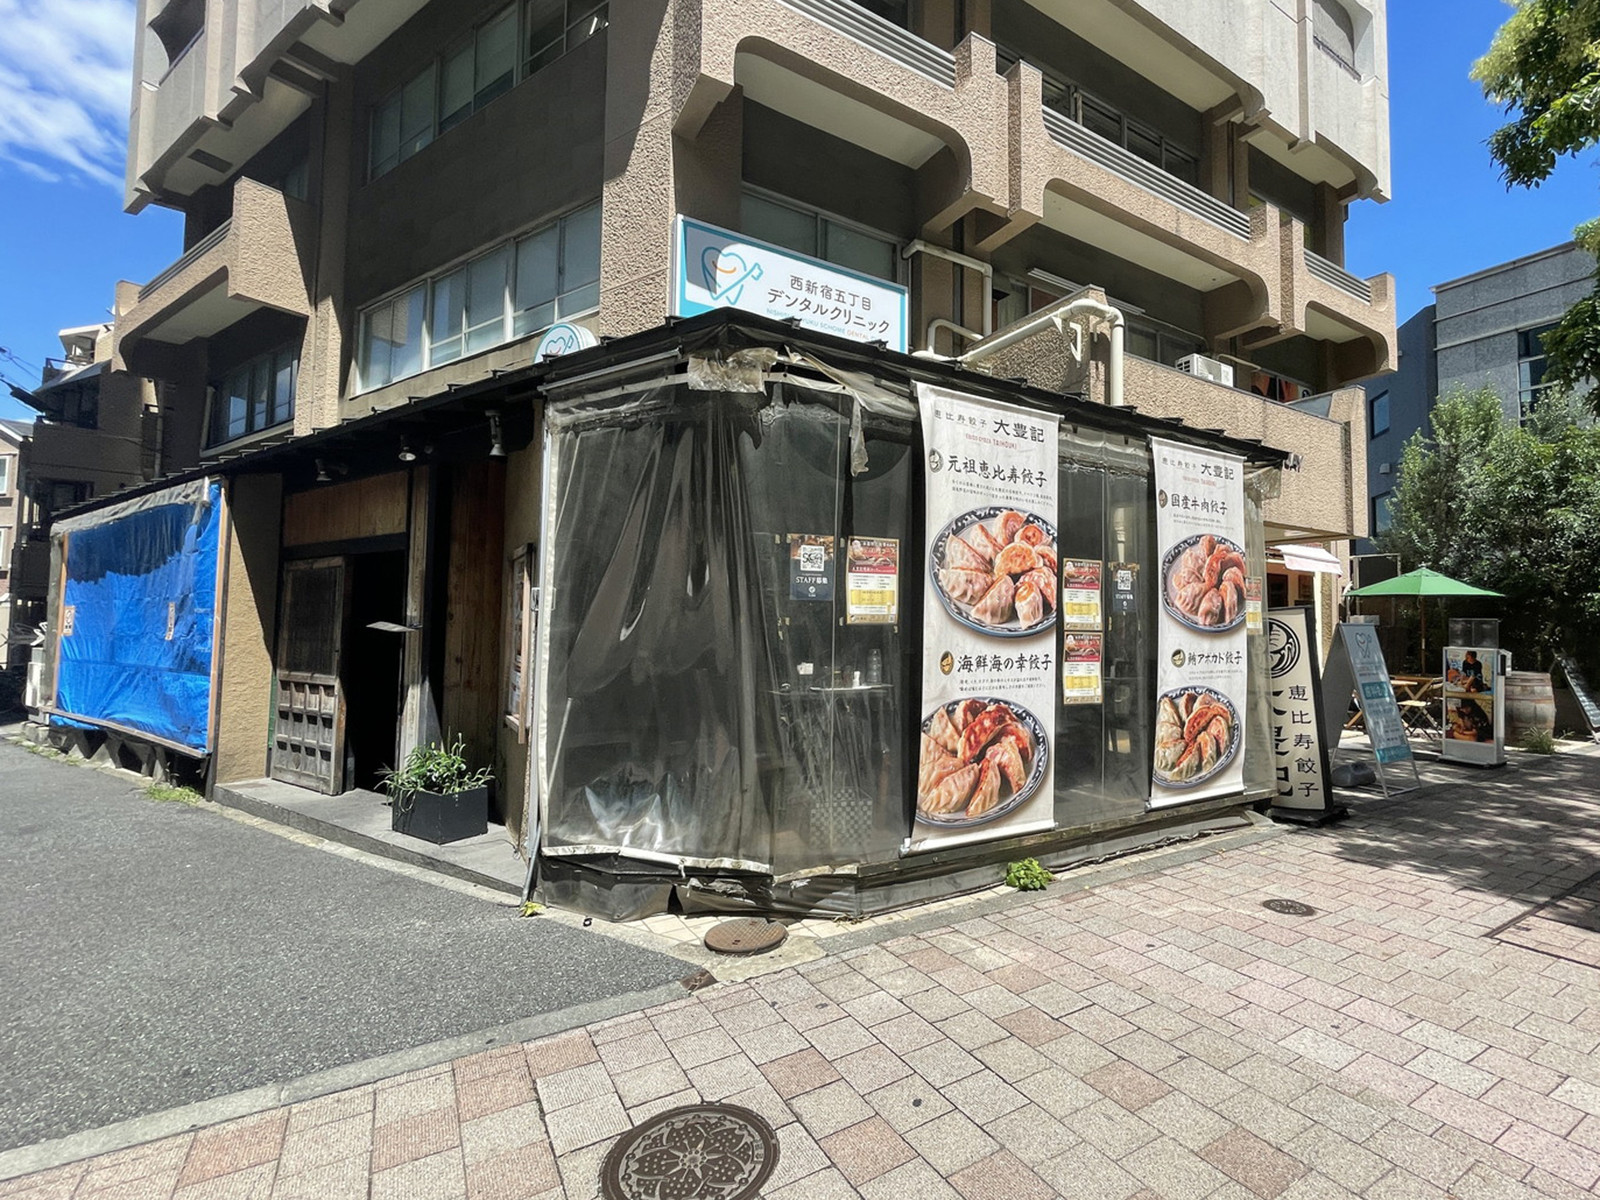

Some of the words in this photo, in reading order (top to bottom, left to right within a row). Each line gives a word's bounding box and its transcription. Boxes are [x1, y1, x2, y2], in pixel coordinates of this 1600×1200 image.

[767, 288, 890, 334] デンタルクリニック
[790, 275, 872, 311] 西新宿五丁目
[947, 455, 1047, 488] 元祖恵比寿餃子
[957, 653, 1053, 673] 海鮮海の幸餃子
[1288, 684, 1319, 797] 恵比寿餃子
